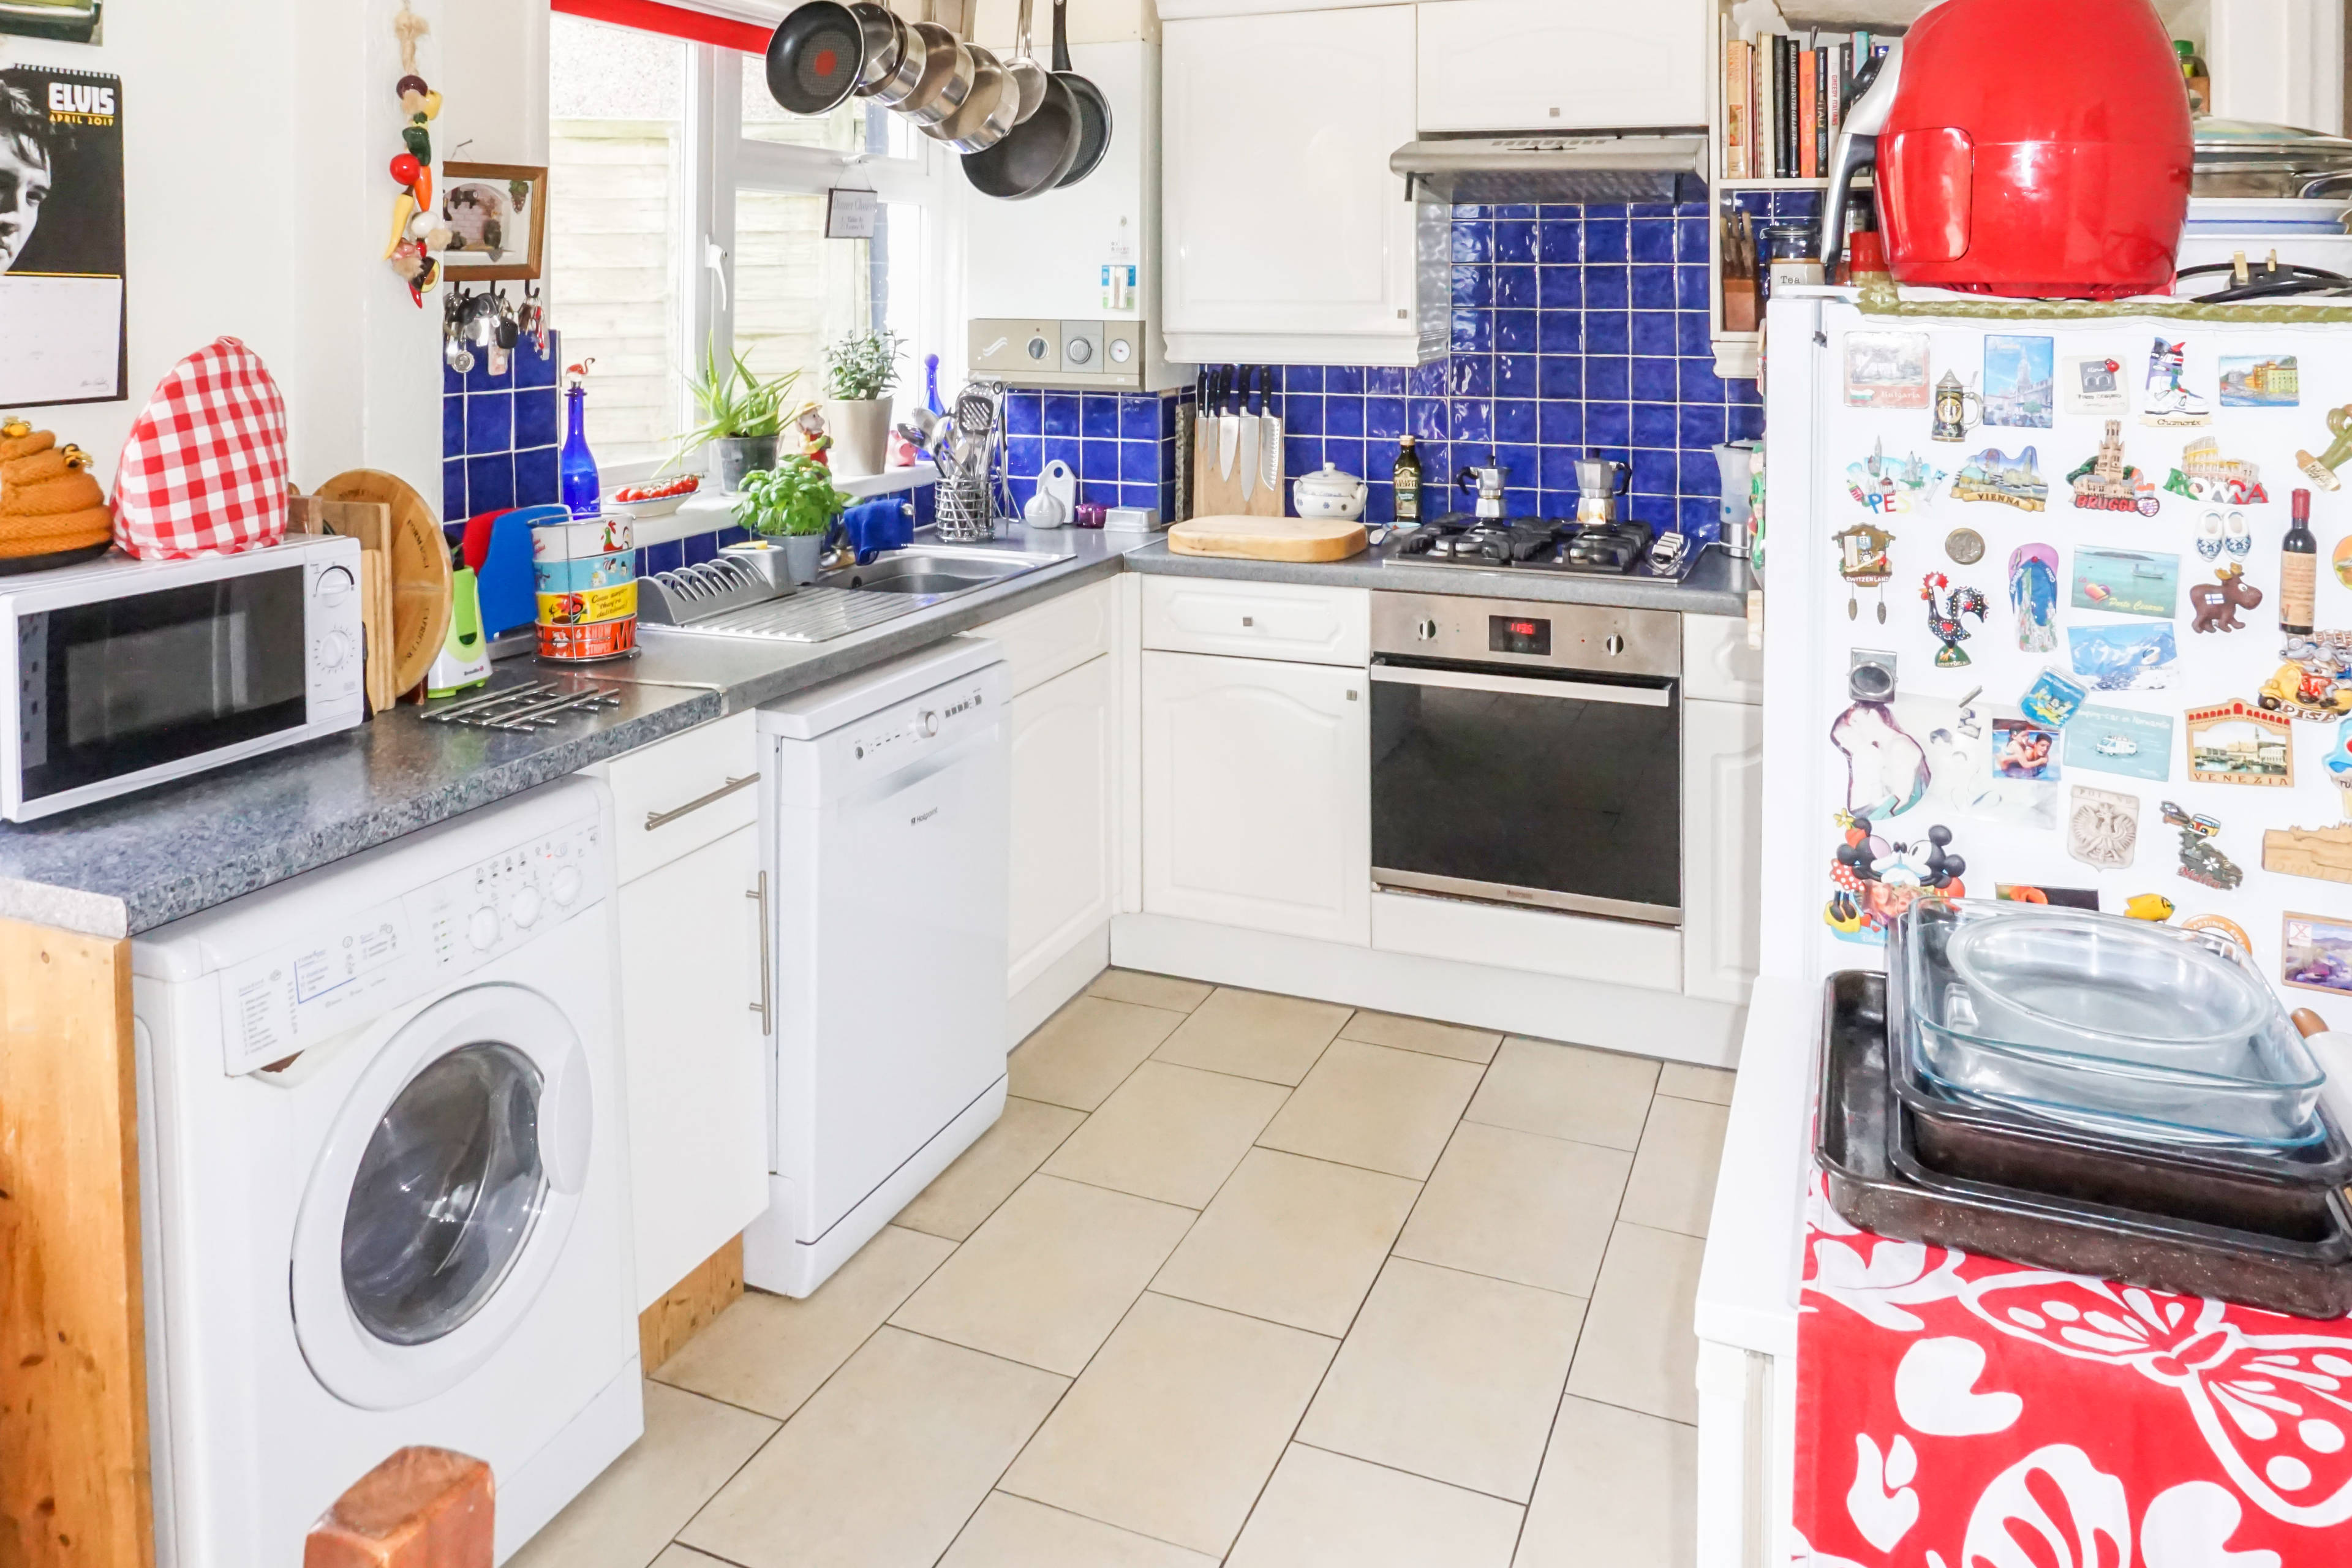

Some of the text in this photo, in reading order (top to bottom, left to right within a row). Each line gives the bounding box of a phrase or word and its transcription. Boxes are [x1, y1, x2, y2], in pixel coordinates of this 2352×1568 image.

[49, 82, 115, 115] ELVIS
[50, 113, 113, 126] APRIL 2019
[1881, 391, 1921, 400] Bulgaria
[2163, 468, 2269, 505] ROMA
[1977, 492, 2021, 507] VIENNA
[2075, 494, 2138, 513] BRUGGE
[2282, 704, 2337, 722] PISA
[2194, 772, 2288, 786] VENEZIA
[916, 806, 938, 823] Hotpoint
